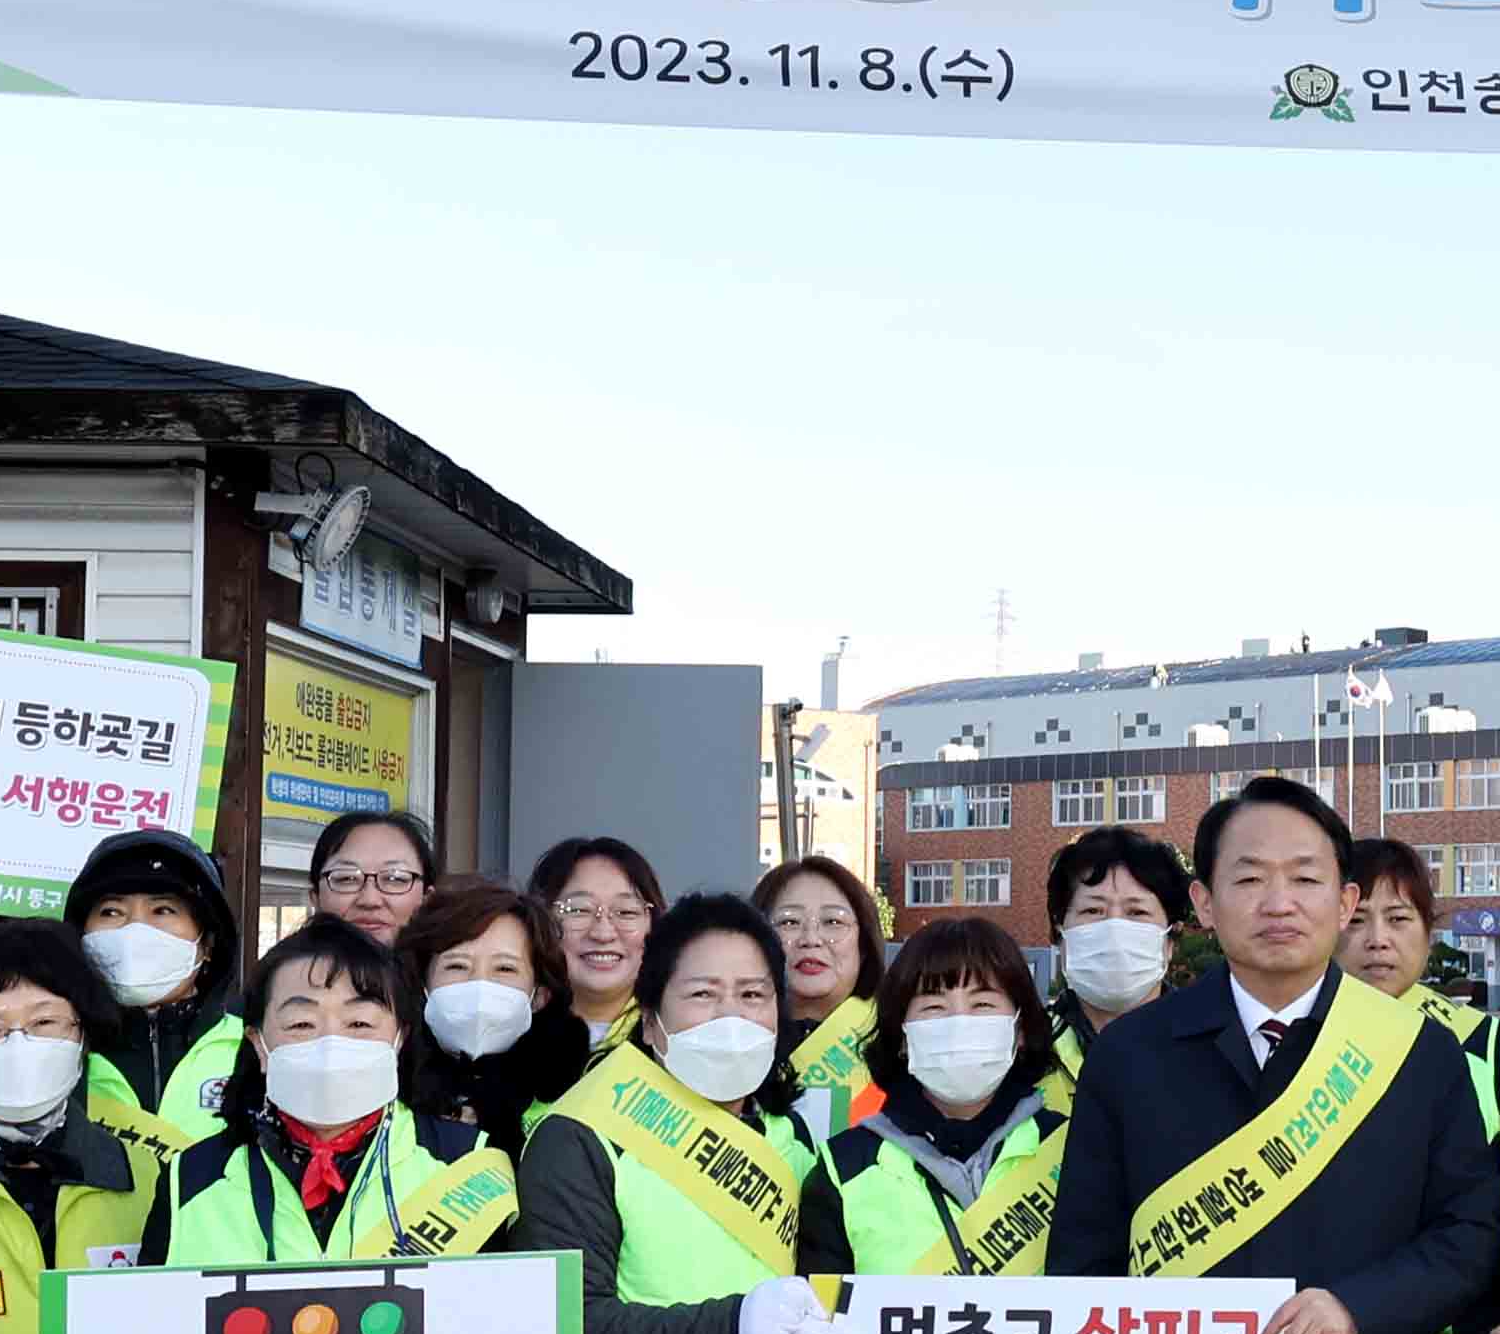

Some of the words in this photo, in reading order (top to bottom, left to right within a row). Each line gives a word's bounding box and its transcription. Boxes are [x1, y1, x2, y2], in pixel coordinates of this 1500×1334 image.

[569, 31, 749, 86] 2023.
[767, 44, 840, 89] 11.
[858, 47, 1016, 101] 8.(수)
[12, 701, 176, 763] 등하굣길
[2, 774, 171, 830] 서행운전
[28, 884, 63, 910] 동구
[1258, 1040, 1376, 1180] 교통안전을
[1129, 1166, 1267, 1278] 생활화합시
